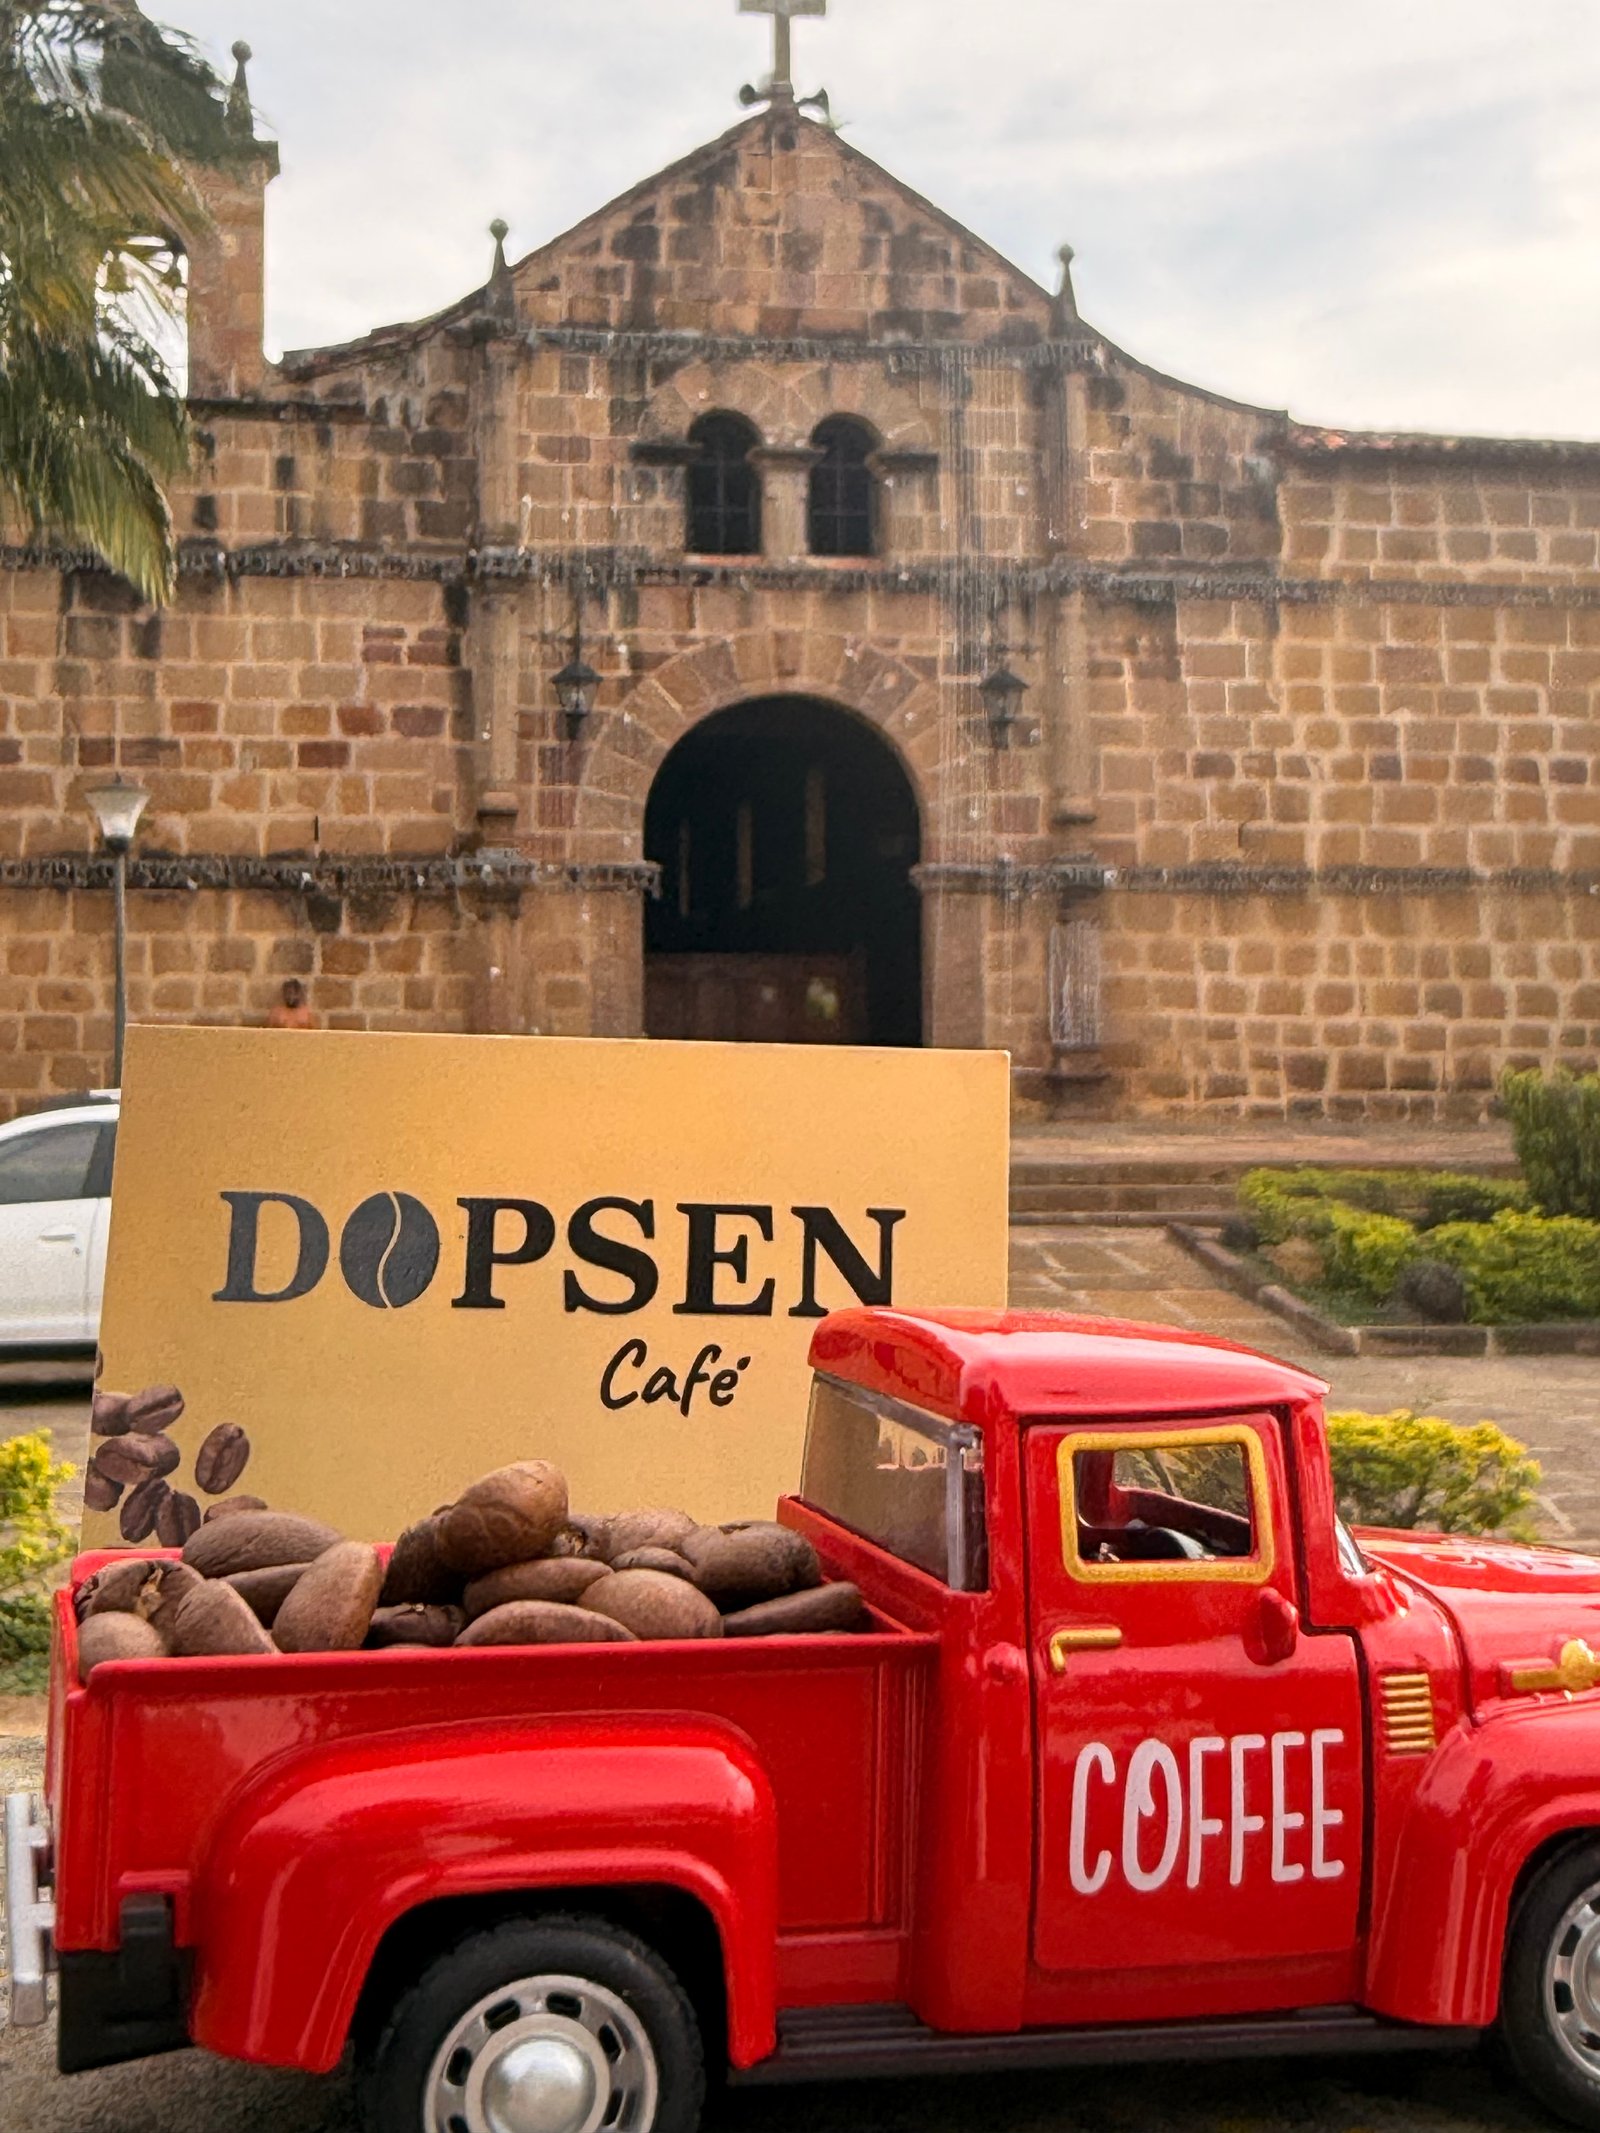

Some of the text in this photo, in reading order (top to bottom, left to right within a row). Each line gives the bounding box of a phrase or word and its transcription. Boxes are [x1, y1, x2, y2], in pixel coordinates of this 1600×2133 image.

[212, 1190, 907, 1317] DOPSEN
[600, 1338, 752, 1417] Café
[1068, 1728, 1346, 1895] COFFEE
